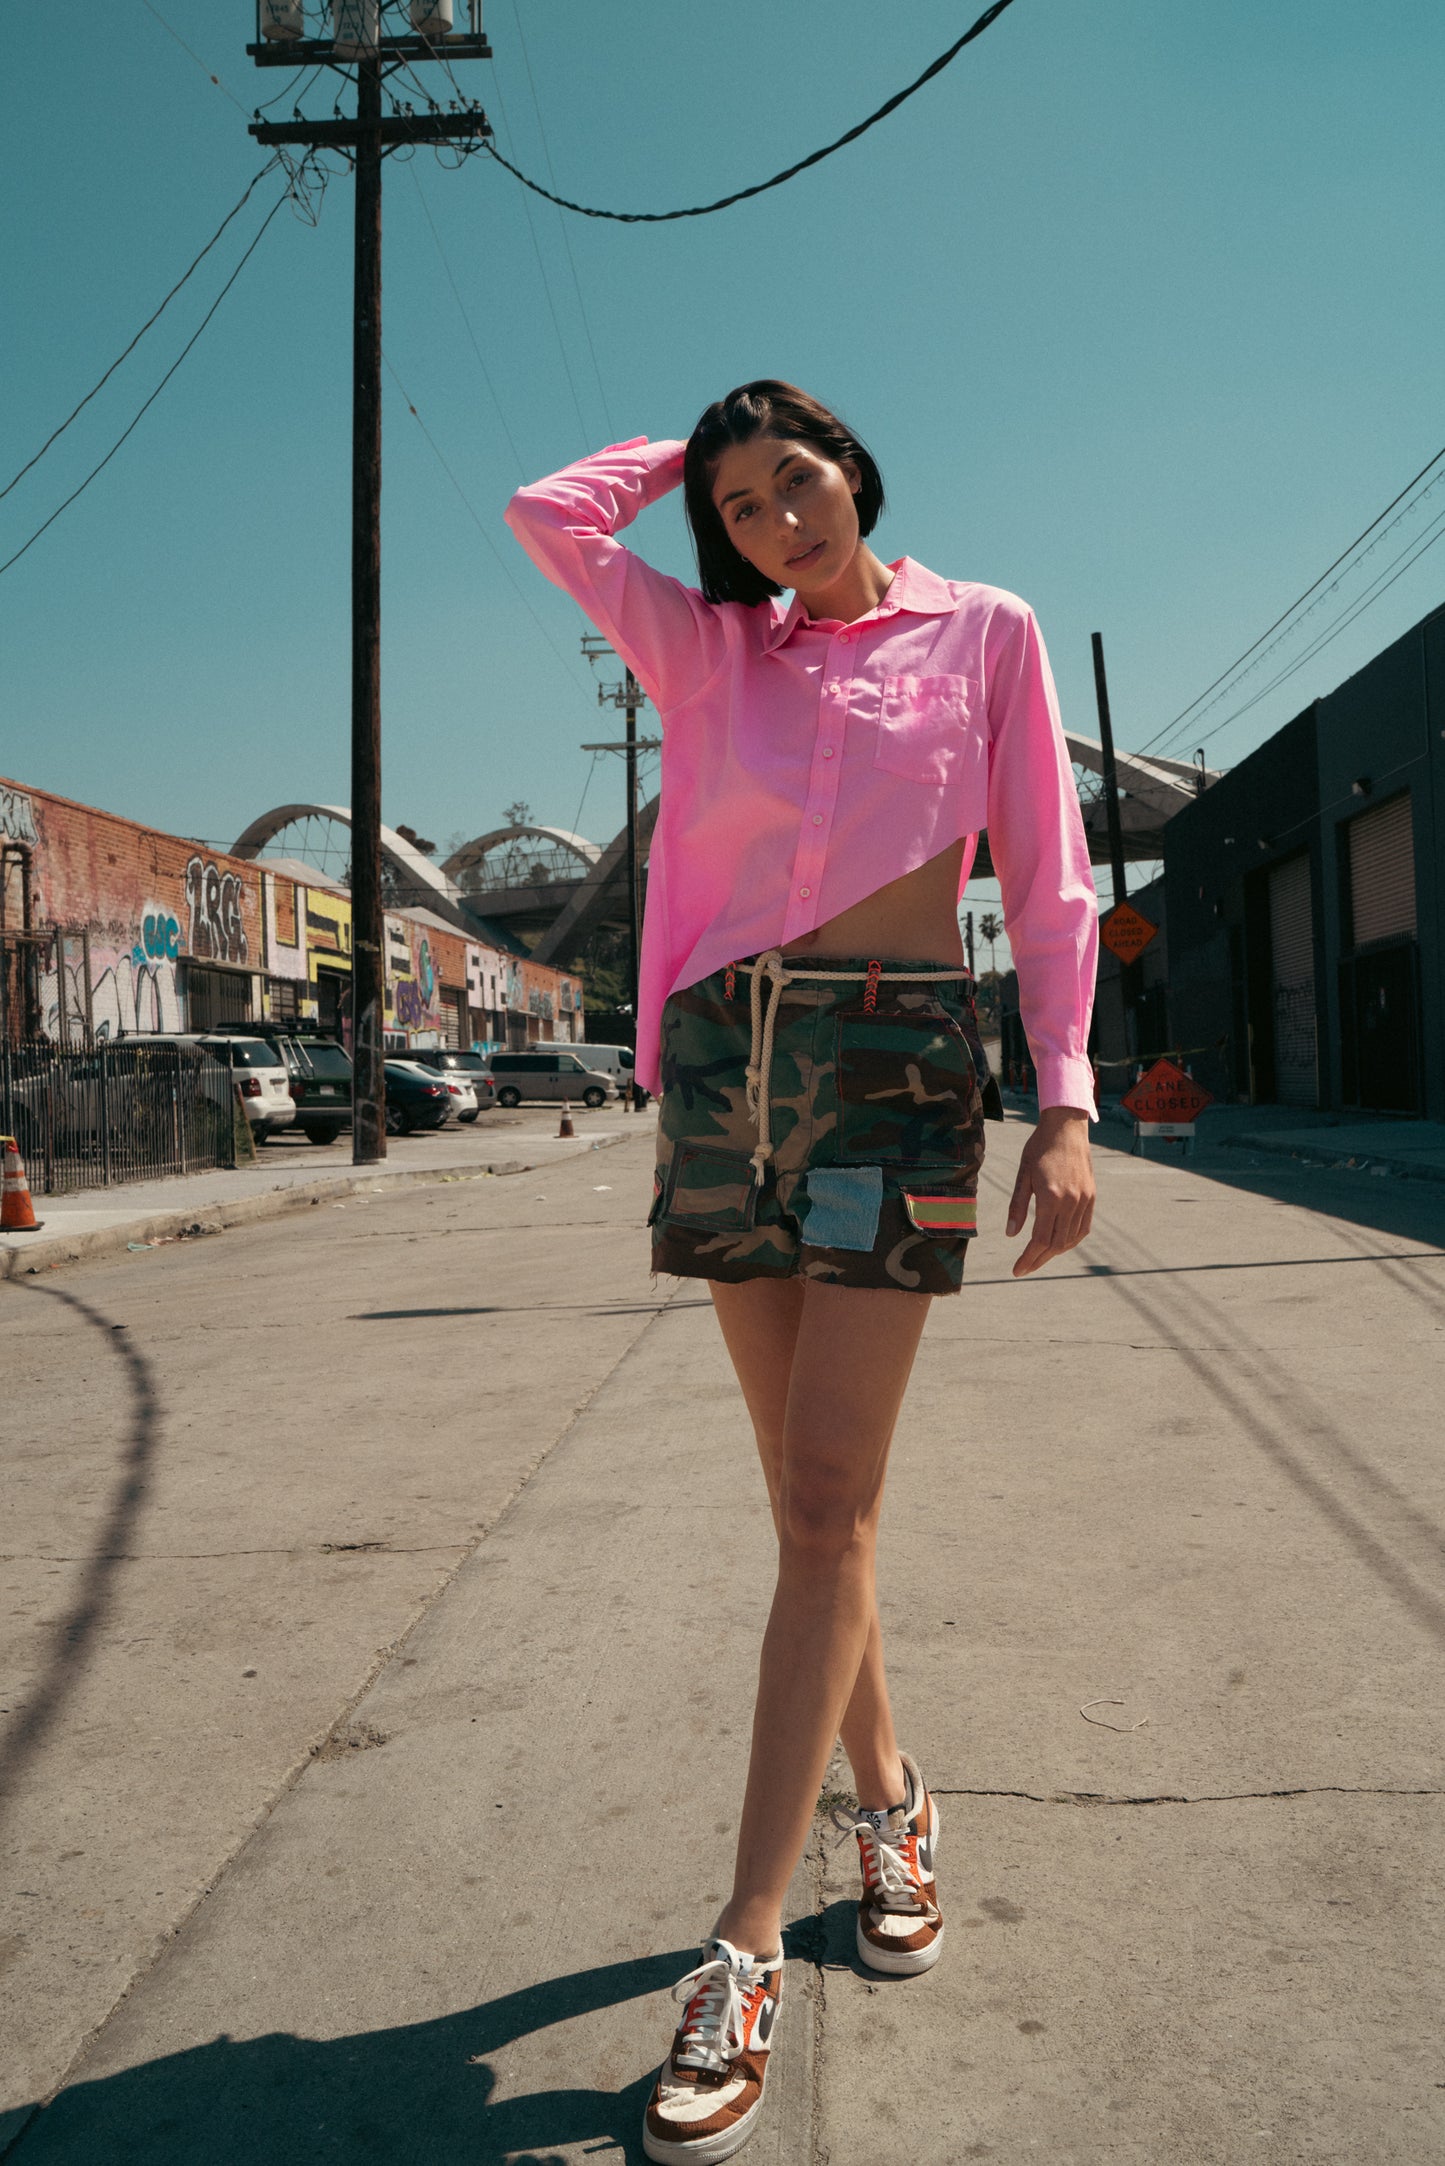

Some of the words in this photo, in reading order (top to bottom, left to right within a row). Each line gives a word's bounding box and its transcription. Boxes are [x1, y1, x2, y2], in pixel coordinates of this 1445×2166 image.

[1113, 917, 1137, 925] ROAD
[1108, 927, 1144, 937] CLOSED
[1113, 938, 1143, 948] AHEAD
[1145, 1081, 1185, 1094] ANE
[1134, 1096, 1200, 1111] CLOSED
